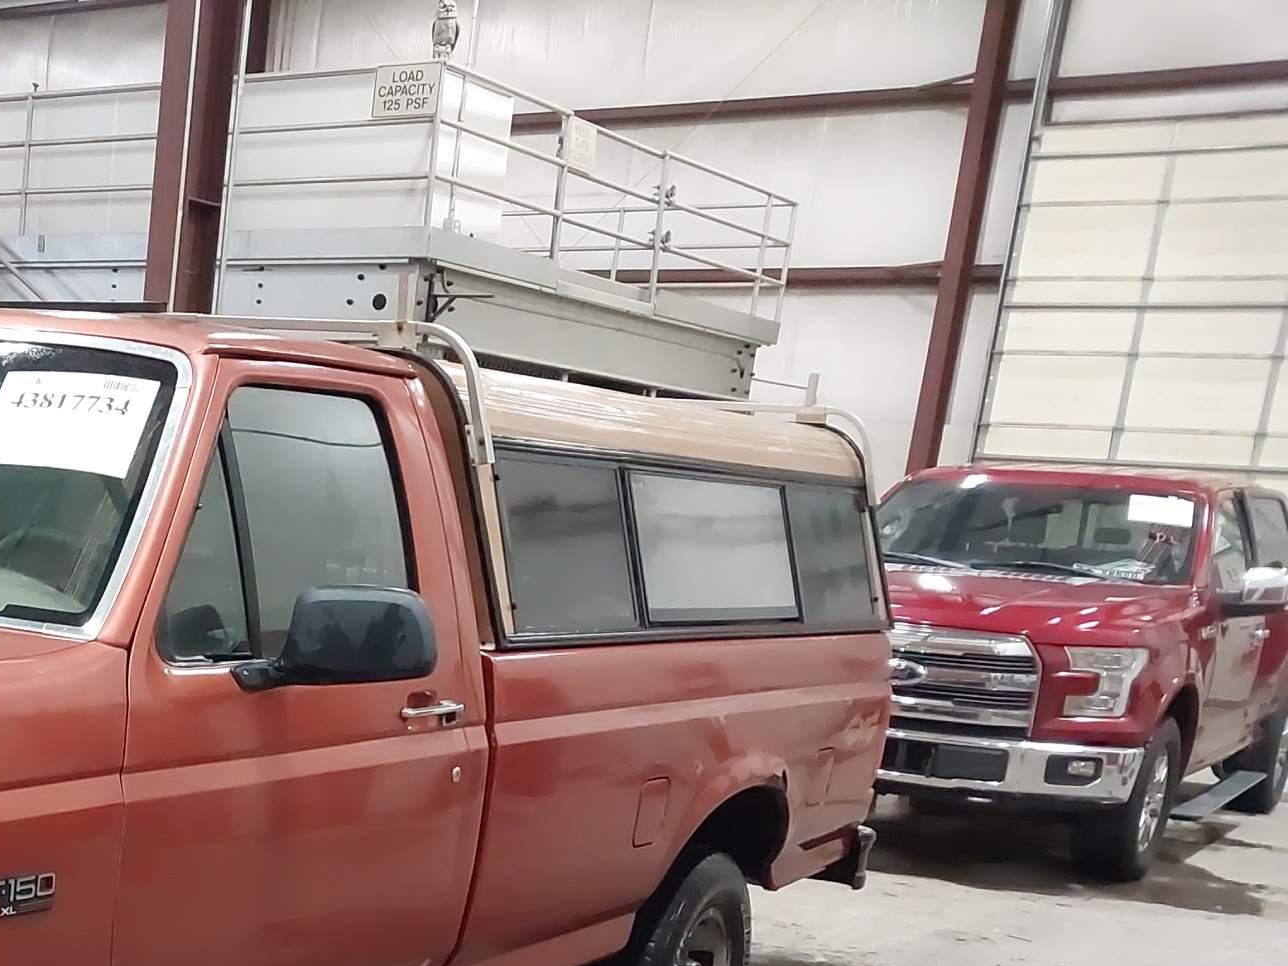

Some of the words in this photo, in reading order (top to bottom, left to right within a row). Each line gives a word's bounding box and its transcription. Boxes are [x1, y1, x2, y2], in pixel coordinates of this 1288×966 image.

[392, 70, 424, 83] LOAD
[378, 83, 435, 98] CAPACITY
[382, 99, 401, 111] 125
[406, 97, 429, 110] PSF
[11, 391, 132, 415] 43817734
[0, 906, 17, 917] XL
